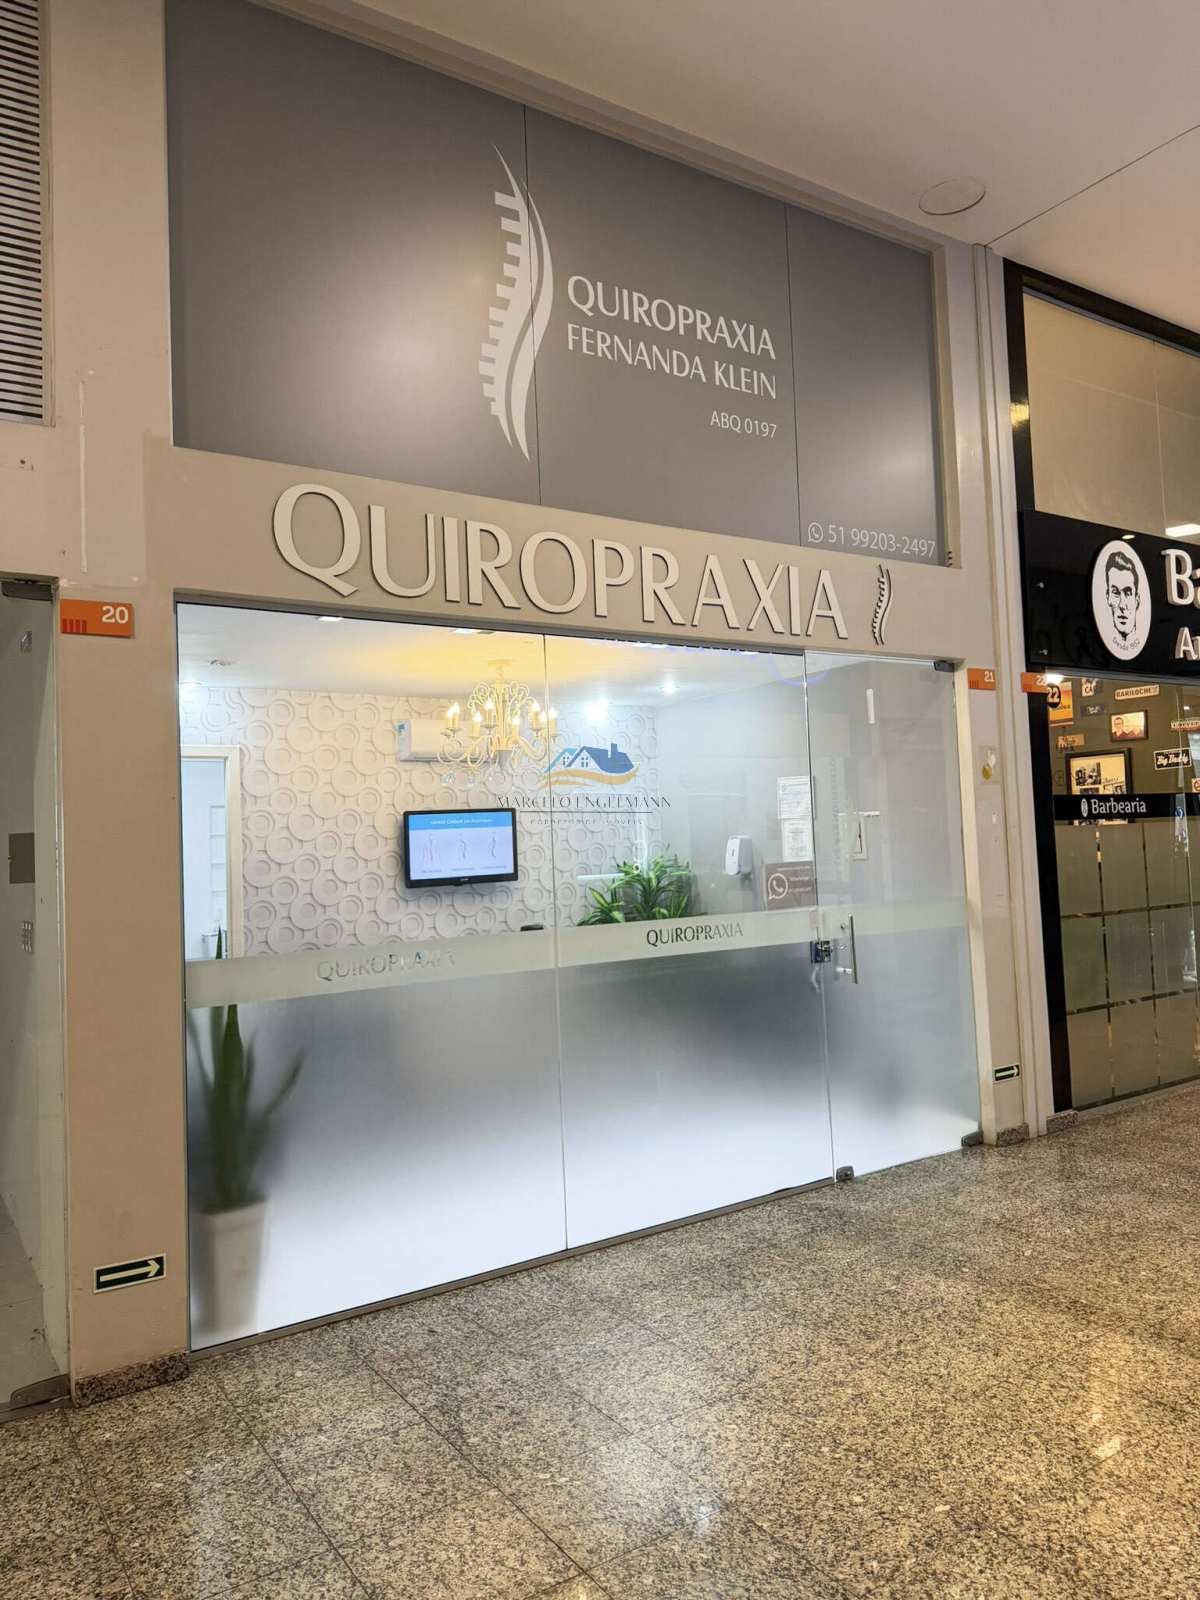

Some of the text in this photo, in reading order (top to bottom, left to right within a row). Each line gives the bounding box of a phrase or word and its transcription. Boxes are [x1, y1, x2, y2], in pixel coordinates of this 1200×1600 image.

[567, 275, 777, 361] QUIROPRAXIA
[567, 323, 777, 400] FERNANDA KLEIN
[709, 410, 777, 439] ABQ 0197
[827, 524, 937, 558] 51 99203-2497
[271, 483, 849, 640] QUIROPRAXIA
[101, 605, 129, 625] 20
[983, 671, 995, 682] 21
[1090, 797, 1147, 814] Barbearia
[646, 922, 744, 947] QUIROPRAXIA
[316, 950, 456, 981] QUIROPAXIA
